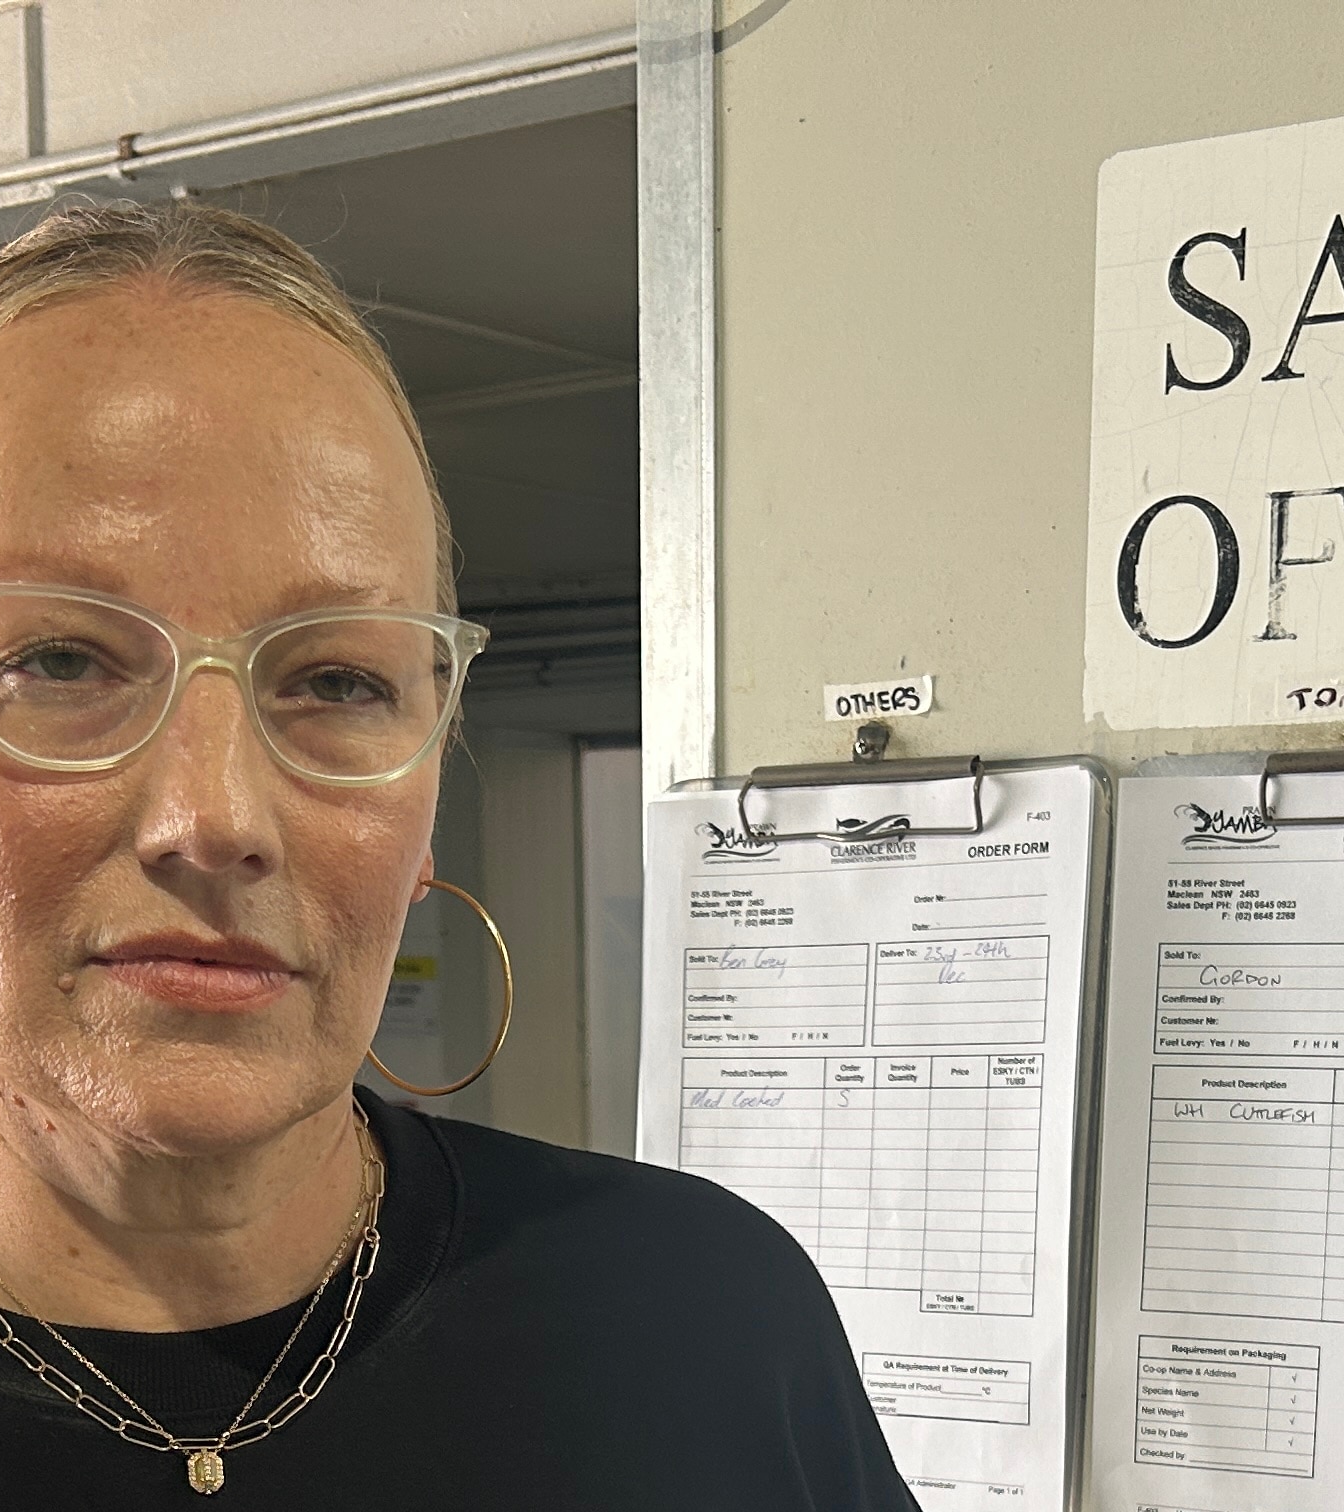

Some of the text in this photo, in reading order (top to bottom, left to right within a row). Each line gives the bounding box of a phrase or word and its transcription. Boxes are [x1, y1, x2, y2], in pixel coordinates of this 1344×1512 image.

[836, 687, 921, 717] OTHERS
[1027, 811, 1051, 822] F-403
[830, 841, 916, 858] CLARENCE RIVER
[968, 841, 1050, 859] ORDER FORM
